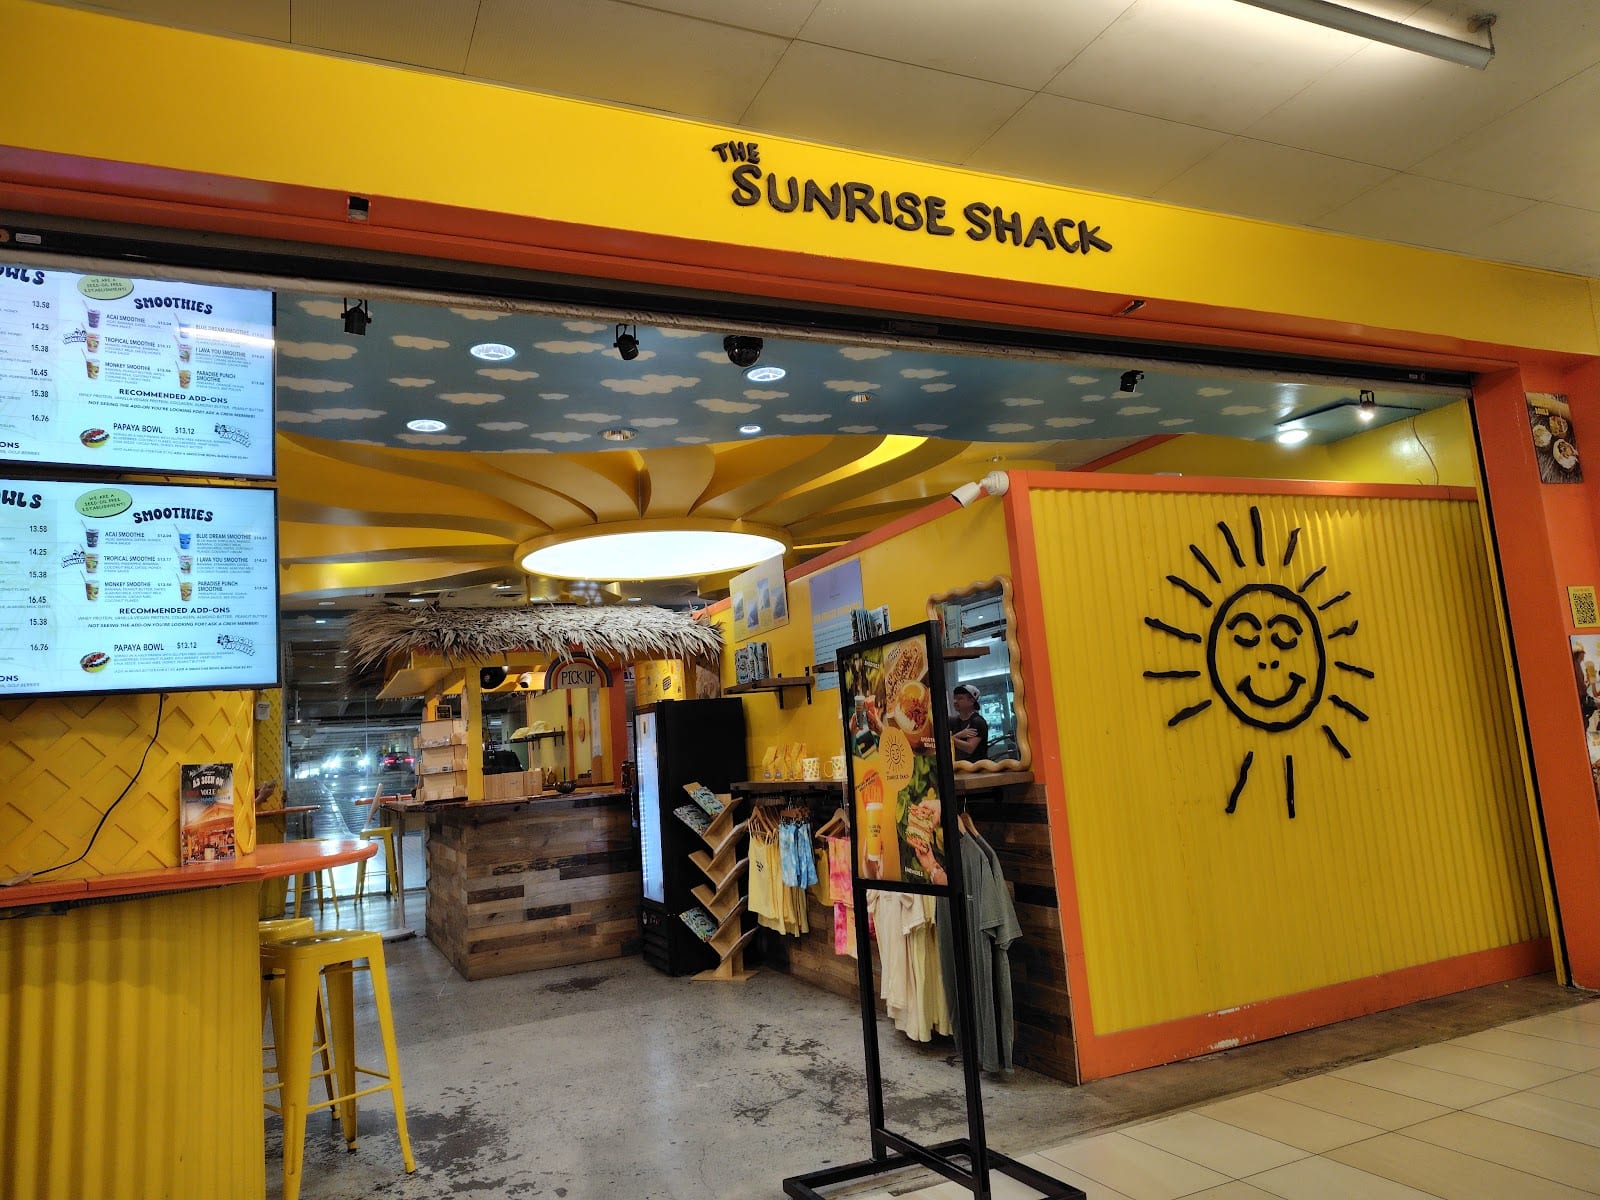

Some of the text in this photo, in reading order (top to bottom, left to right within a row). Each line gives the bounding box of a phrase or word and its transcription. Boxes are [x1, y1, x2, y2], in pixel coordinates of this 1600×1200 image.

[711, 140, 761, 164] THE
[731, 163, 1113, 255] SUNRISE SHACK
[134, 296, 214, 315] SMOOTHIES
[130, 339, 156, 348] SMOOTHIE
[120, 389, 228, 403] RECOMMENDED ADD-ONS
[113, 423, 140, 432] PAPAYA
[142, 425, 162, 434] BOWL
[0, 490, 42, 508] WLS
[133, 507, 214, 524] SMOOTHIES
[561, 670, 596, 685] PICK UP
[193, 776, 224, 788] AS SEEN ON
